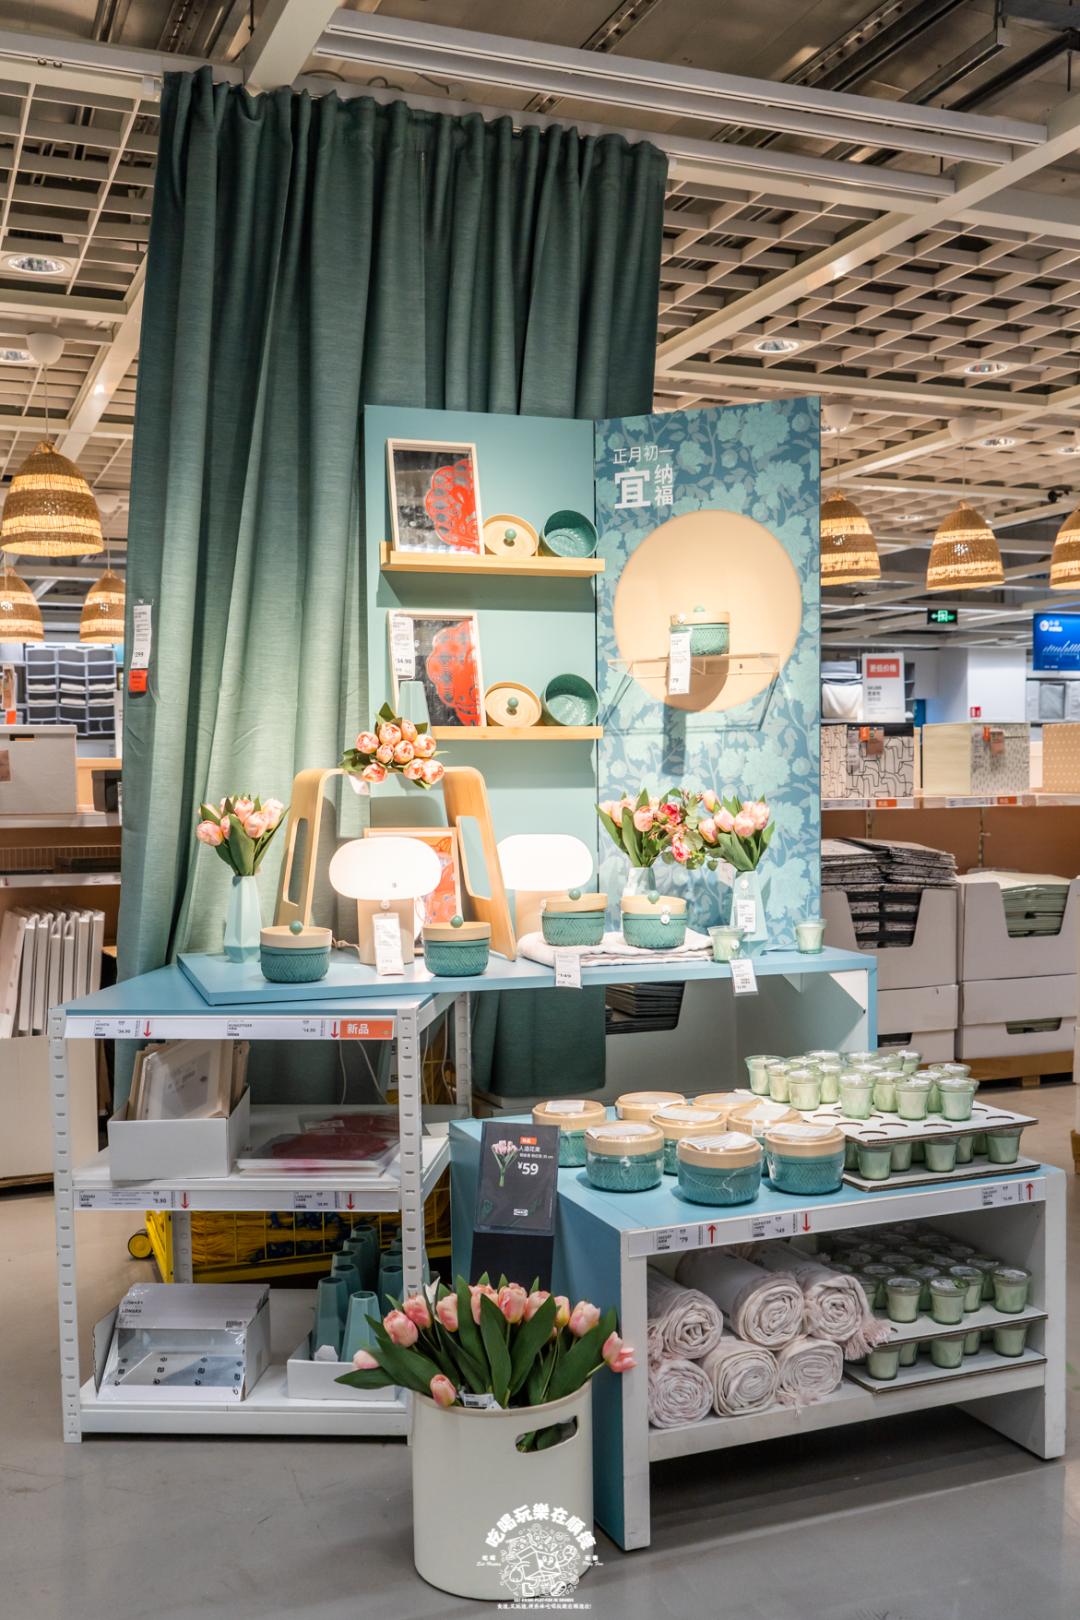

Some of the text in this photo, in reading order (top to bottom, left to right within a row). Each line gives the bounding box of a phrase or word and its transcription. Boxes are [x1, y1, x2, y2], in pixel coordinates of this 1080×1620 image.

[613, 445, 674, 464] 正月初一
[614, 467, 651, 509] 宜
[654, 463, 674, 506] 纳福
[347, 1023, 369, 1035] 新品
[517, 1161, 539, 1175] ¥59
